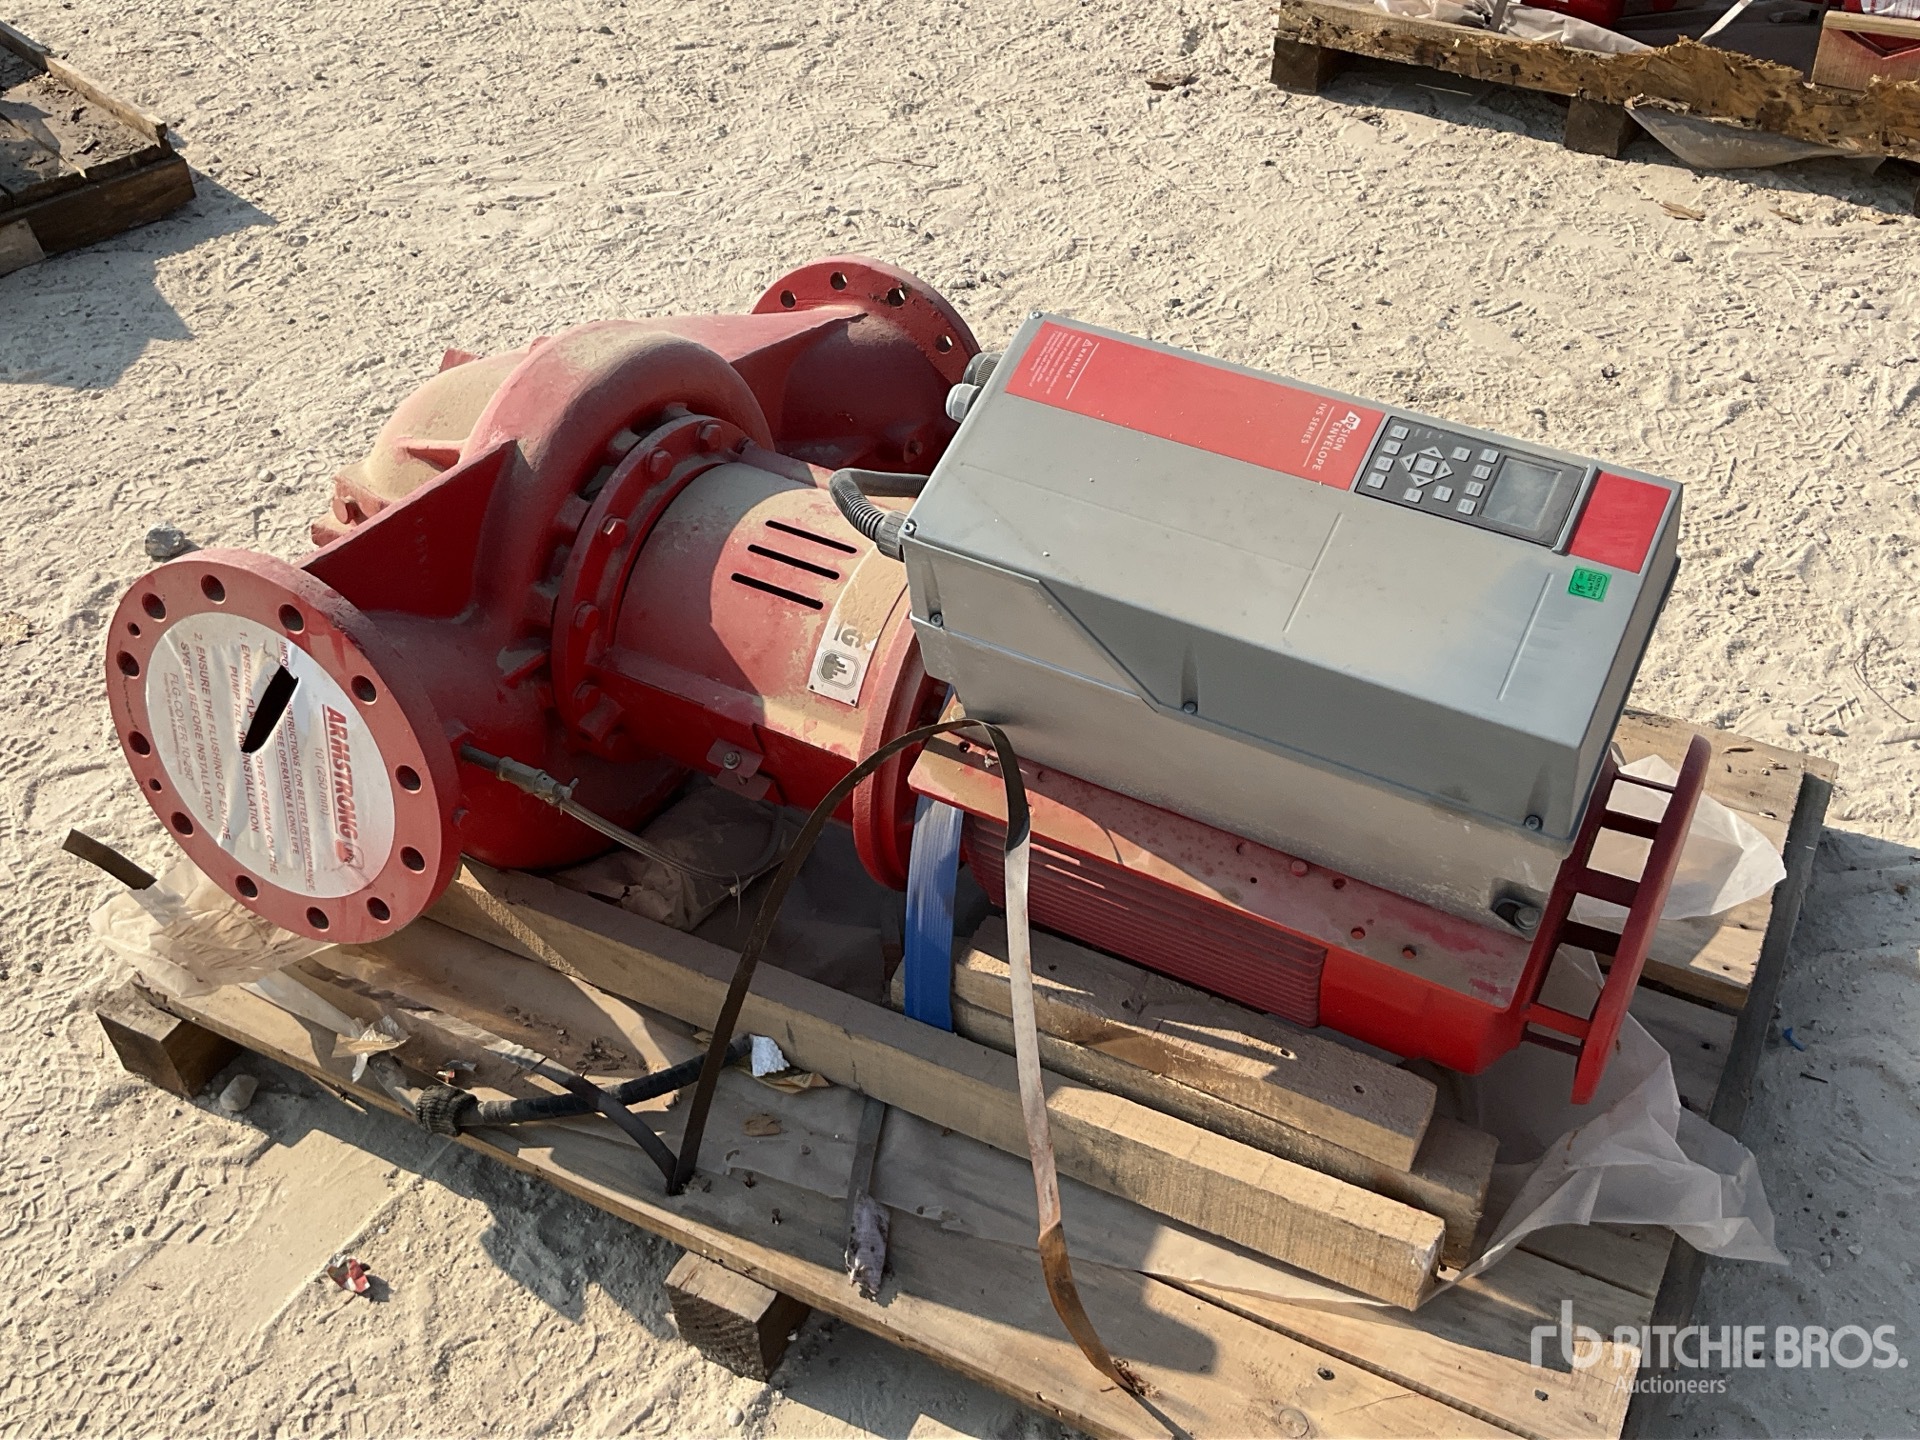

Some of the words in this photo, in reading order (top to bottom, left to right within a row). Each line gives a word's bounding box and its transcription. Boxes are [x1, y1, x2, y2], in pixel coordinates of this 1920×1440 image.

[1065, 347, 1086, 379] WARNING
[1315, 402, 1327, 416] IVS
[1300, 416, 1319, 444] SERIES
[1311, 422, 1341, 471] ENVELOPE
[1332, 415, 1356, 451] DESIGN
[193, 631, 203, 643] 2.
[239, 630, 247, 640] 1.
[180, 641, 194, 691] SYSTEM
[195, 645, 211, 695] ENSURE
[228, 665, 240, 700] PUMP
[239, 643, 255, 696] ENSURE
[188, 692, 203, 740] BEFORE
[203, 698, 214, 720] THE
[233, 702, 243, 727] TILL
[207, 722, 223, 779] FLUSHING
[195, 741, 214, 821] INSTALLATION
[216, 781, 226, 798] OF
[278, 749, 291, 800] OPERATION
[294, 768, 302, 787] FOR
[327, 706, 359, 841] ARMSTRONG
[241, 752, 259, 833] INSTALLATION
[286, 801, 293, 809] &
[297, 788, 307, 823] BETTER
[217, 799, 231, 841] ENTIRE
[260, 789, 272, 833] REMAIN
[287, 809, 296, 835] LONG
[265, 835, 274, 850] ON
[290, 836, 299, 855] LIFE
[301, 824, 315, 891] PERFORMANCE
[267, 853, 277, 875] THE
